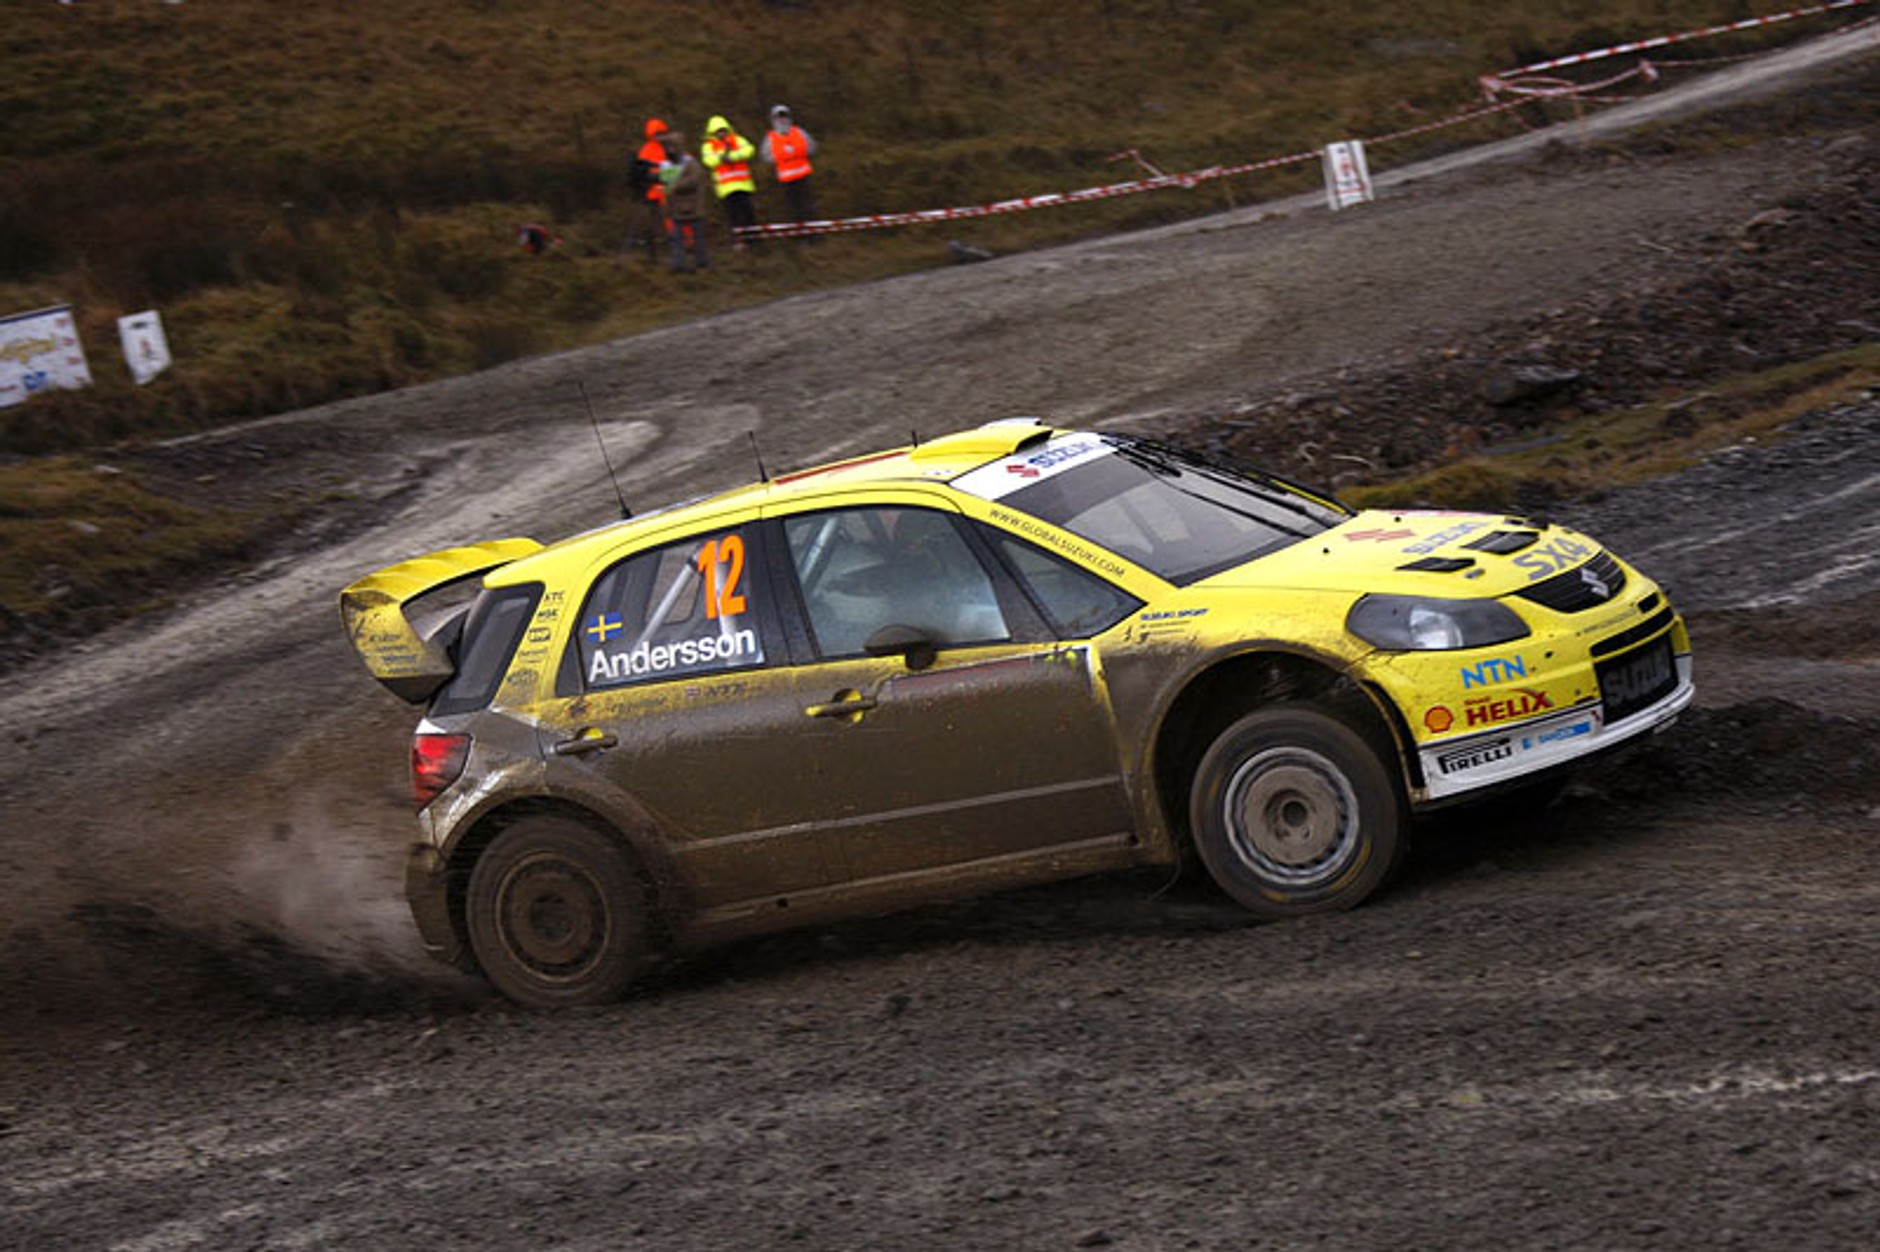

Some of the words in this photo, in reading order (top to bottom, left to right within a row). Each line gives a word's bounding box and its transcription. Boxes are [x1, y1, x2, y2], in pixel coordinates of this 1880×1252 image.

[989, 509, 1126, 578] WWW.GLOBALSUZUKI.COM
[1513, 537, 1592, 581] SX4
[698, 535, 747, 620] 12
[588, 629, 756, 683] Andersson
[1461, 655, 1528, 690] NTN
[1465, 690, 1553, 727] HELIX
[1437, 738, 1513, 775] PIRELLI
